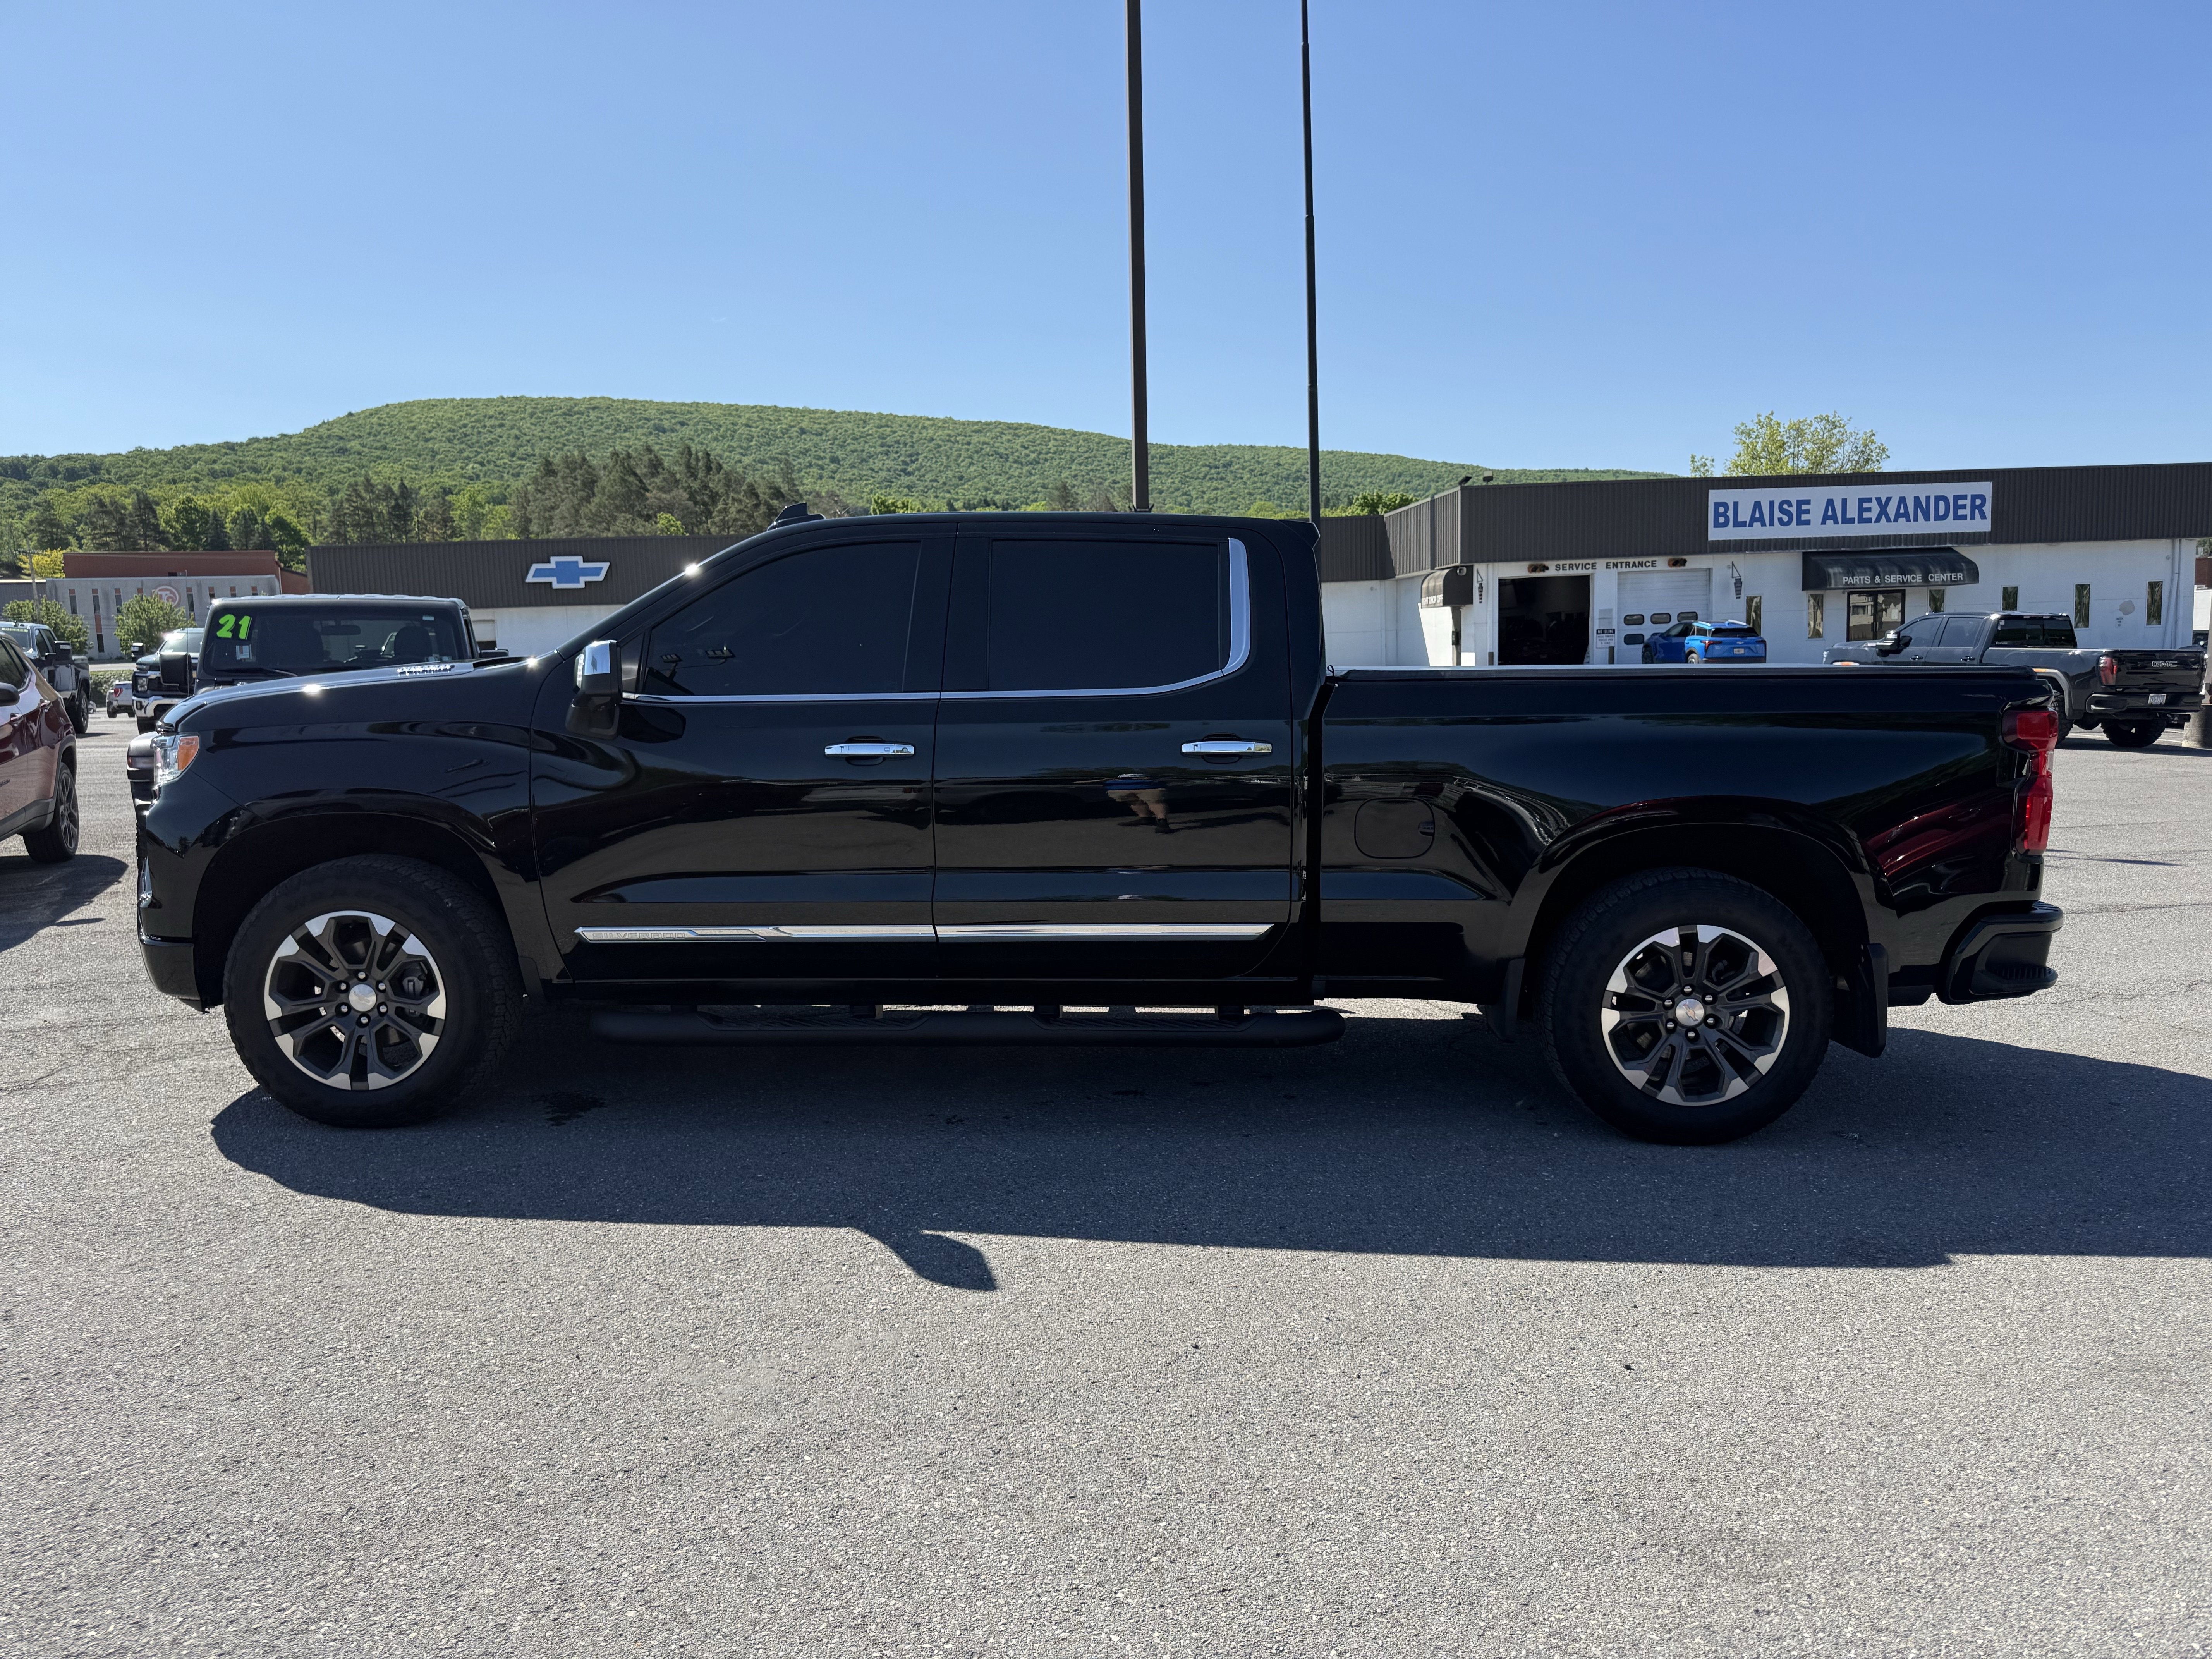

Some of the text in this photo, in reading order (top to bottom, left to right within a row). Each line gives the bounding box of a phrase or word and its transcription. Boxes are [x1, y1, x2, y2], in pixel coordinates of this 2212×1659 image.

[1713, 493, 1987, 528] BLAISE ALEXANDER
[1555, 560, 1657, 571] SERVICE ENTRANCE
[1843, 572, 1963, 584] PARTS & SERVICE CENTER
[216, 614, 252, 640] 21
